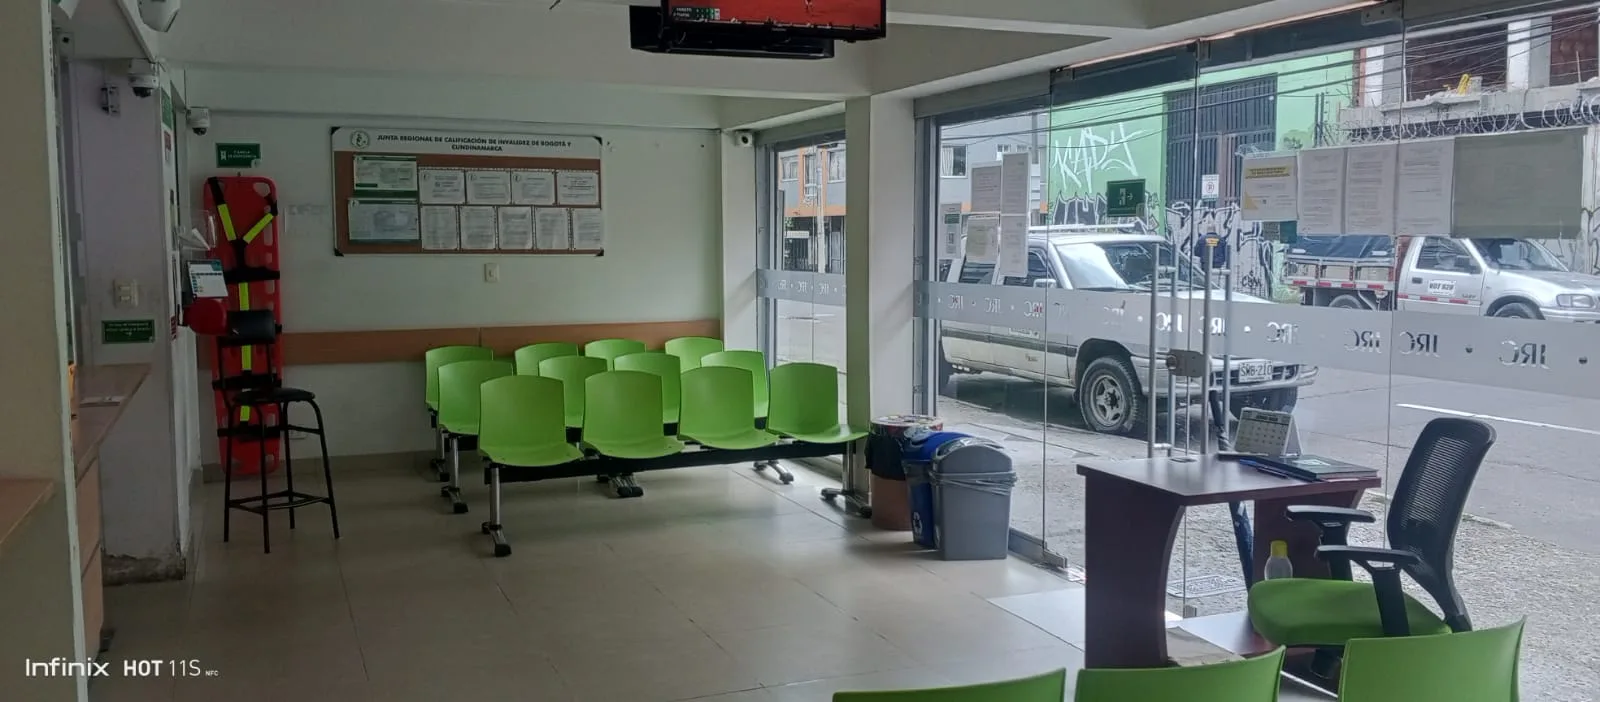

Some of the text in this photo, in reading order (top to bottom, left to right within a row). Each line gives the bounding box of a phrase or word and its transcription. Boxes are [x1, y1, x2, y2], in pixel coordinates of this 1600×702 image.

[399, 135, 433, 143] REGIONAL
[444, 136, 488, 145] CALIFICACIÓN
[498, 138, 530, 146] INVALIDEZ
[451, 144, 503, 152] CUNDINAMARCA
